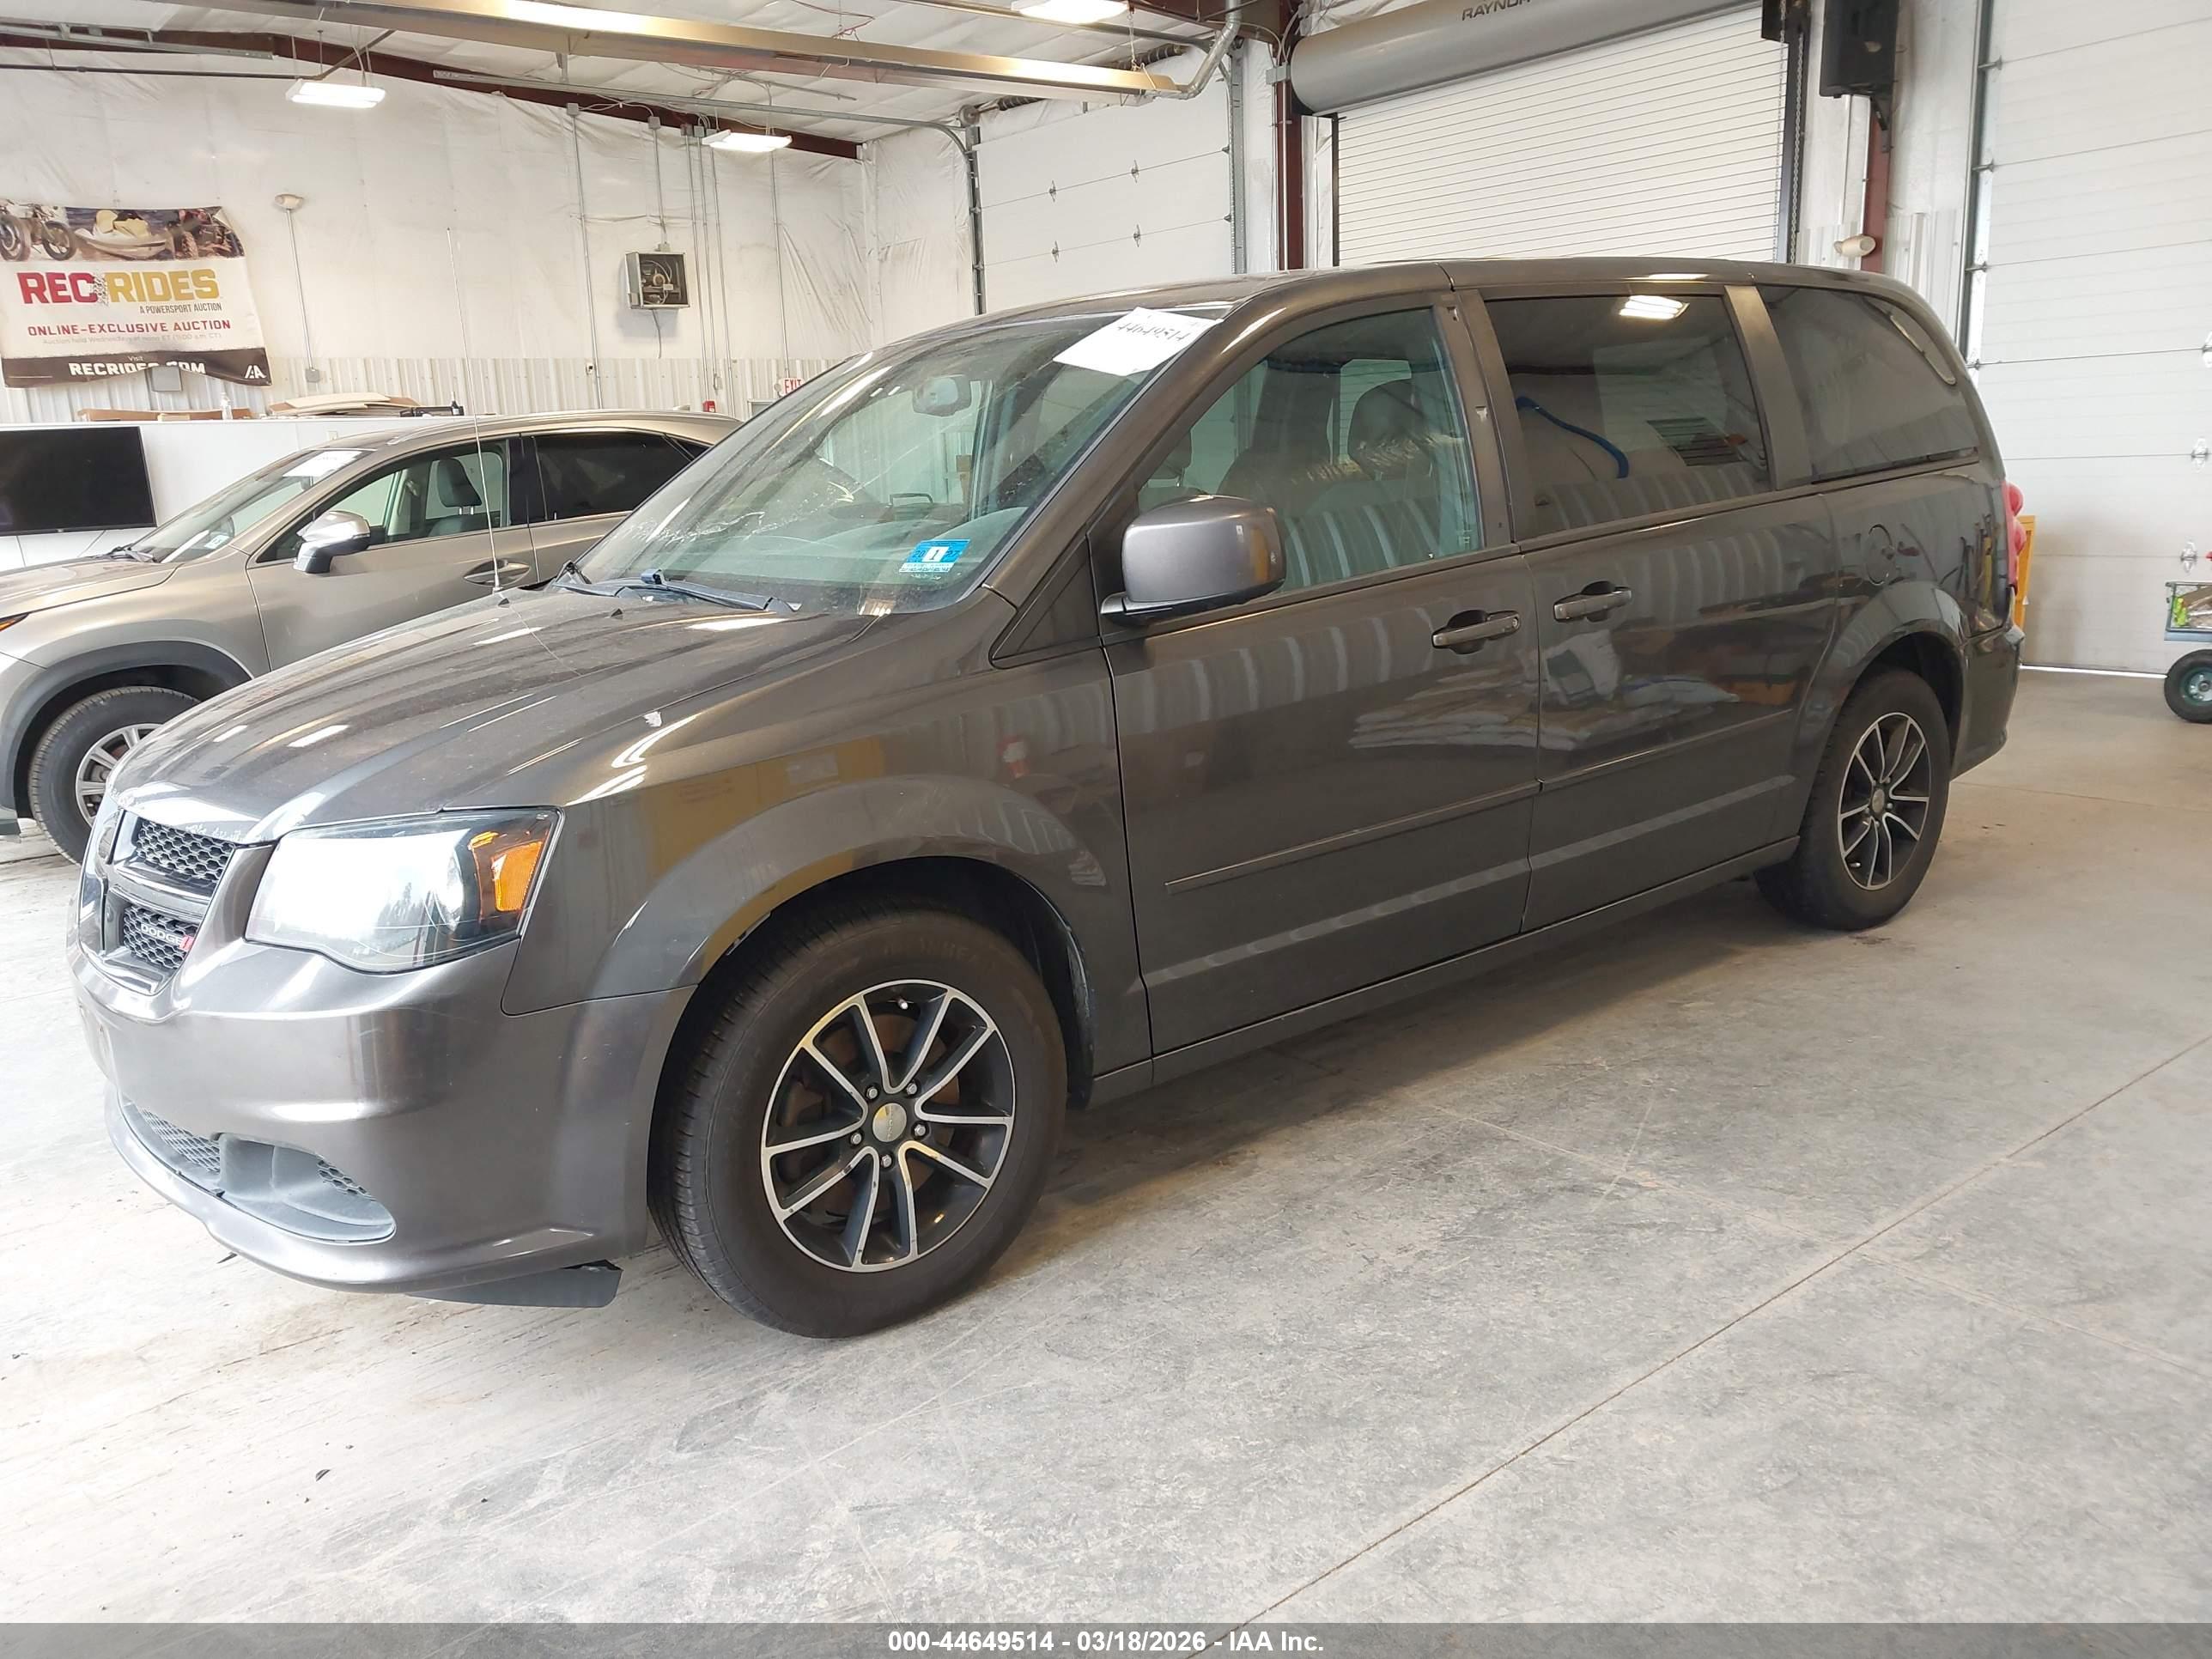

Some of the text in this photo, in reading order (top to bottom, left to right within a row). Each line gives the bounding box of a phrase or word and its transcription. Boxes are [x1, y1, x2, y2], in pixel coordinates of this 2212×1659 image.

[104, 269, 221, 301] RIDES
[139, 302, 222, 314] A POWERSPORT AUCTION
[27, 319, 231, 337] ONLINE-EXCLUSIVE AUCTION
[68, 362, 206, 375] RECRIDEOM
[928, 549, 939, 561] 1
[141, 924, 183, 945] DODGE
